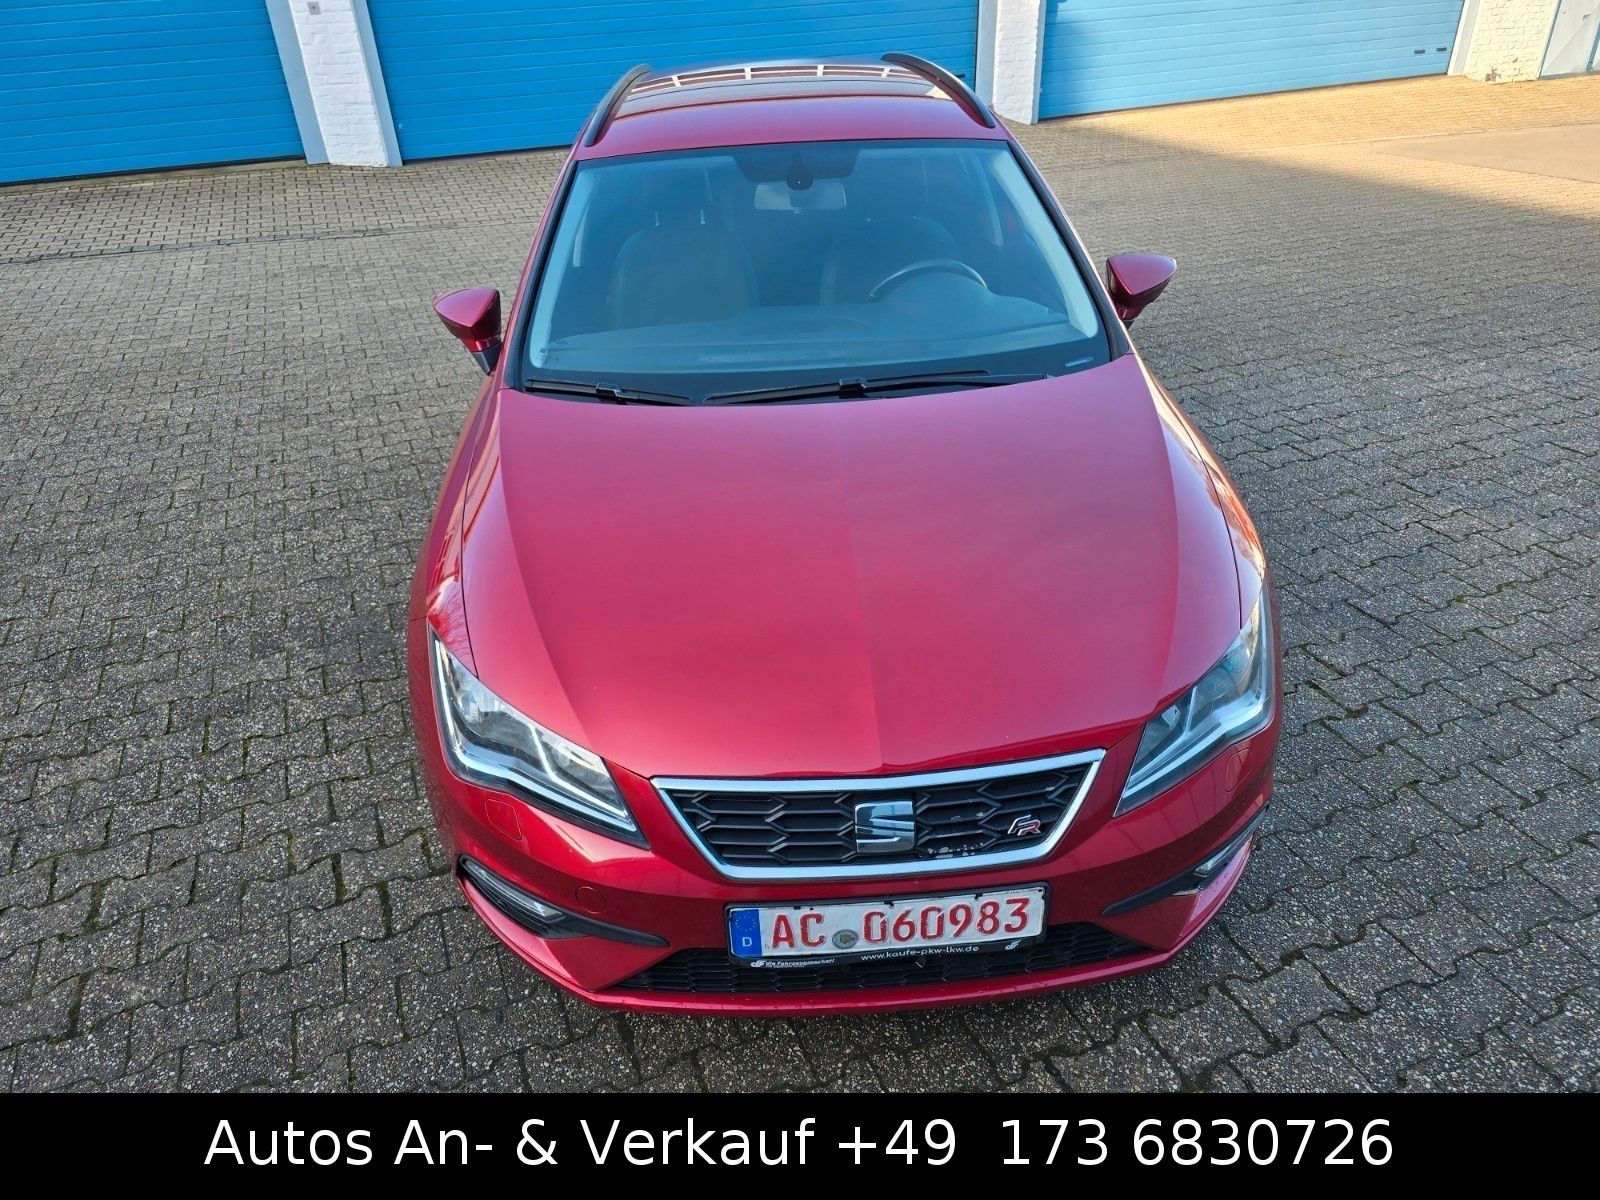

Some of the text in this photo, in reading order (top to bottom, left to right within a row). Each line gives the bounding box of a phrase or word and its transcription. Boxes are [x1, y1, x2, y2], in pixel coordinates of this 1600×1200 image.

[1007, 814, 1041, 837] FR
[771, 897, 1031, 949] AC 060983
[742, 936, 753, 947] D
[860, 945, 980, 961] www.kaufe-pkw-lkw.de
